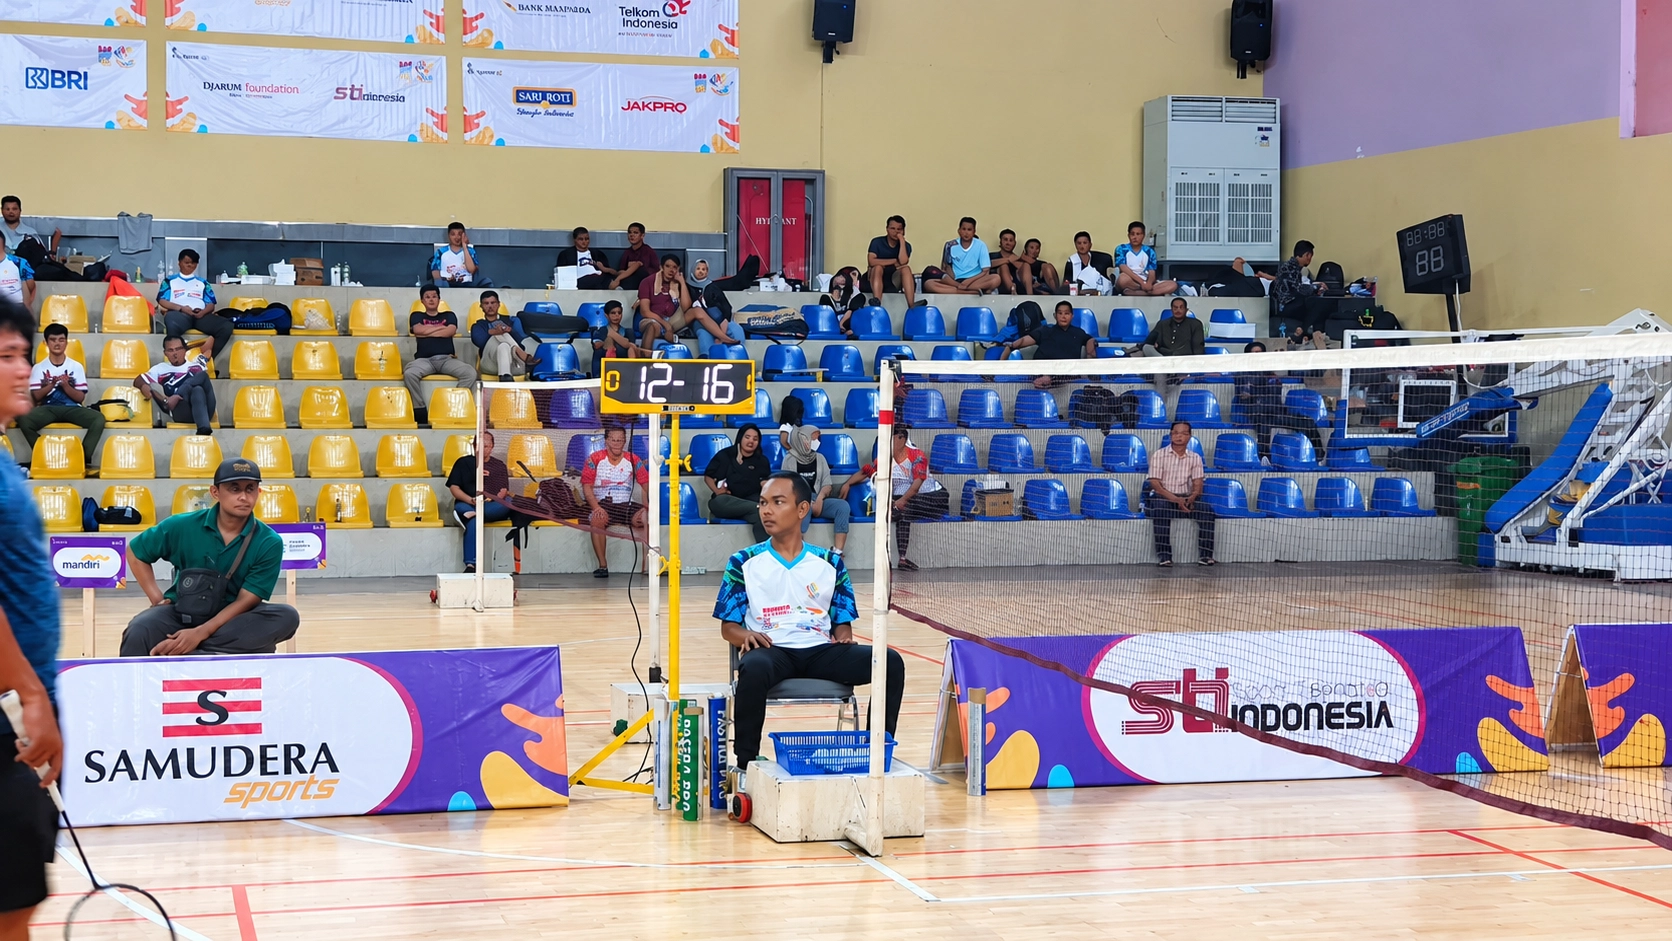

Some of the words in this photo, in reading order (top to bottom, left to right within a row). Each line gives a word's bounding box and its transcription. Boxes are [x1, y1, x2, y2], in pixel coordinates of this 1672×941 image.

[518, 4, 543, 12] BANK
[618, 6, 660, 18] Telkom
[622, 17, 678, 29] Indonesia
[50, 69, 88, 90] BRI
[203, 81, 242, 91] DJARUM
[245, 82, 299, 94] foundation
[518, 91, 542, 101] SARI
[621, 100, 687, 114] JAKPRO
[755, 217, 797, 225] HYANT
[62, 560, 100, 569] mandiri
[1120, 667, 1229, 735] sti
[1231, 700, 1394, 733] INDONESIA
[84, 742, 340, 784] SAMUDERA
[223, 774, 340, 809] sports
